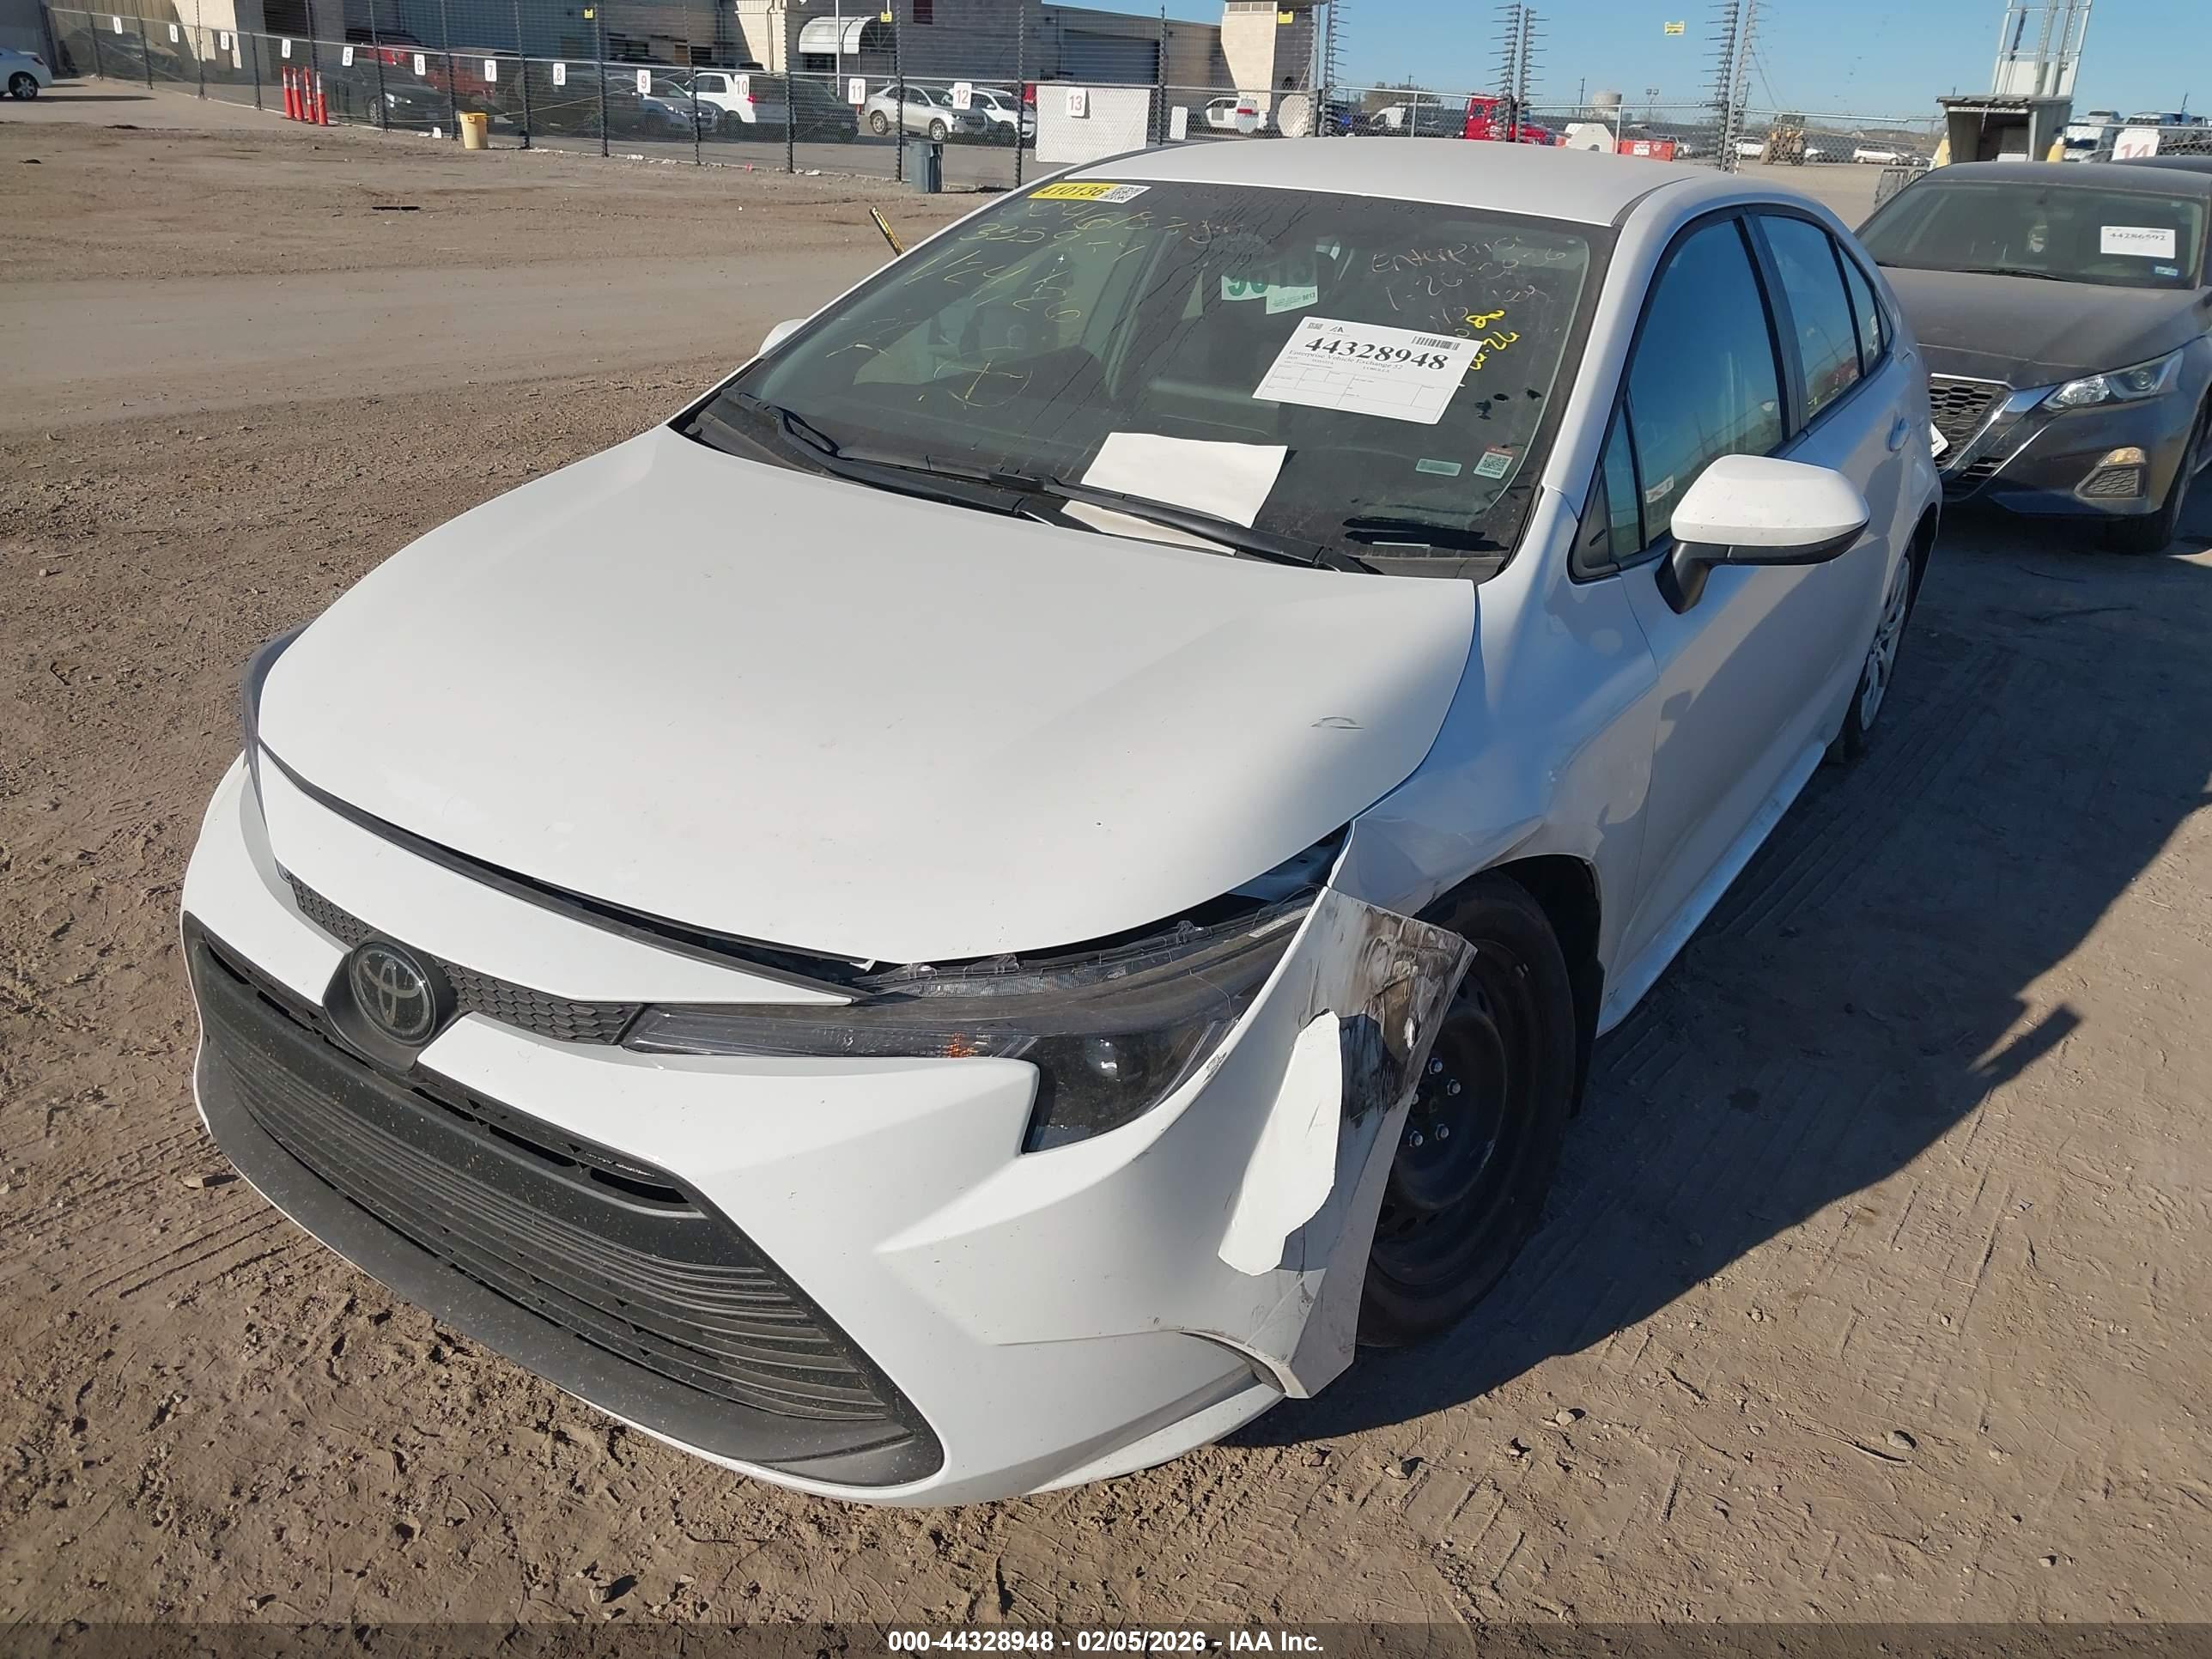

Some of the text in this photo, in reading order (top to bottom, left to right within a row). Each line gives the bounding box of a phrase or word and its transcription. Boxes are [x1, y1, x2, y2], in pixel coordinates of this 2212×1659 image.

[344, 50, 351, 64] 5
[416, 58, 423, 72] 6
[487, 64, 495, 79] 7
[556, 68, 562, 82] 8
[640, 75, 647, 90] 9
[735, 79, 749, 95] 10
[851, 84, 863, 100] 11
[956, 88, 969, 105] 12
[1069, 94, 1083, 112] 13
[2120, 143, 2151, 160] 14
[1039, 185, 1110, 197] 410136
[1304, 337, 1449, 371] 44328948
